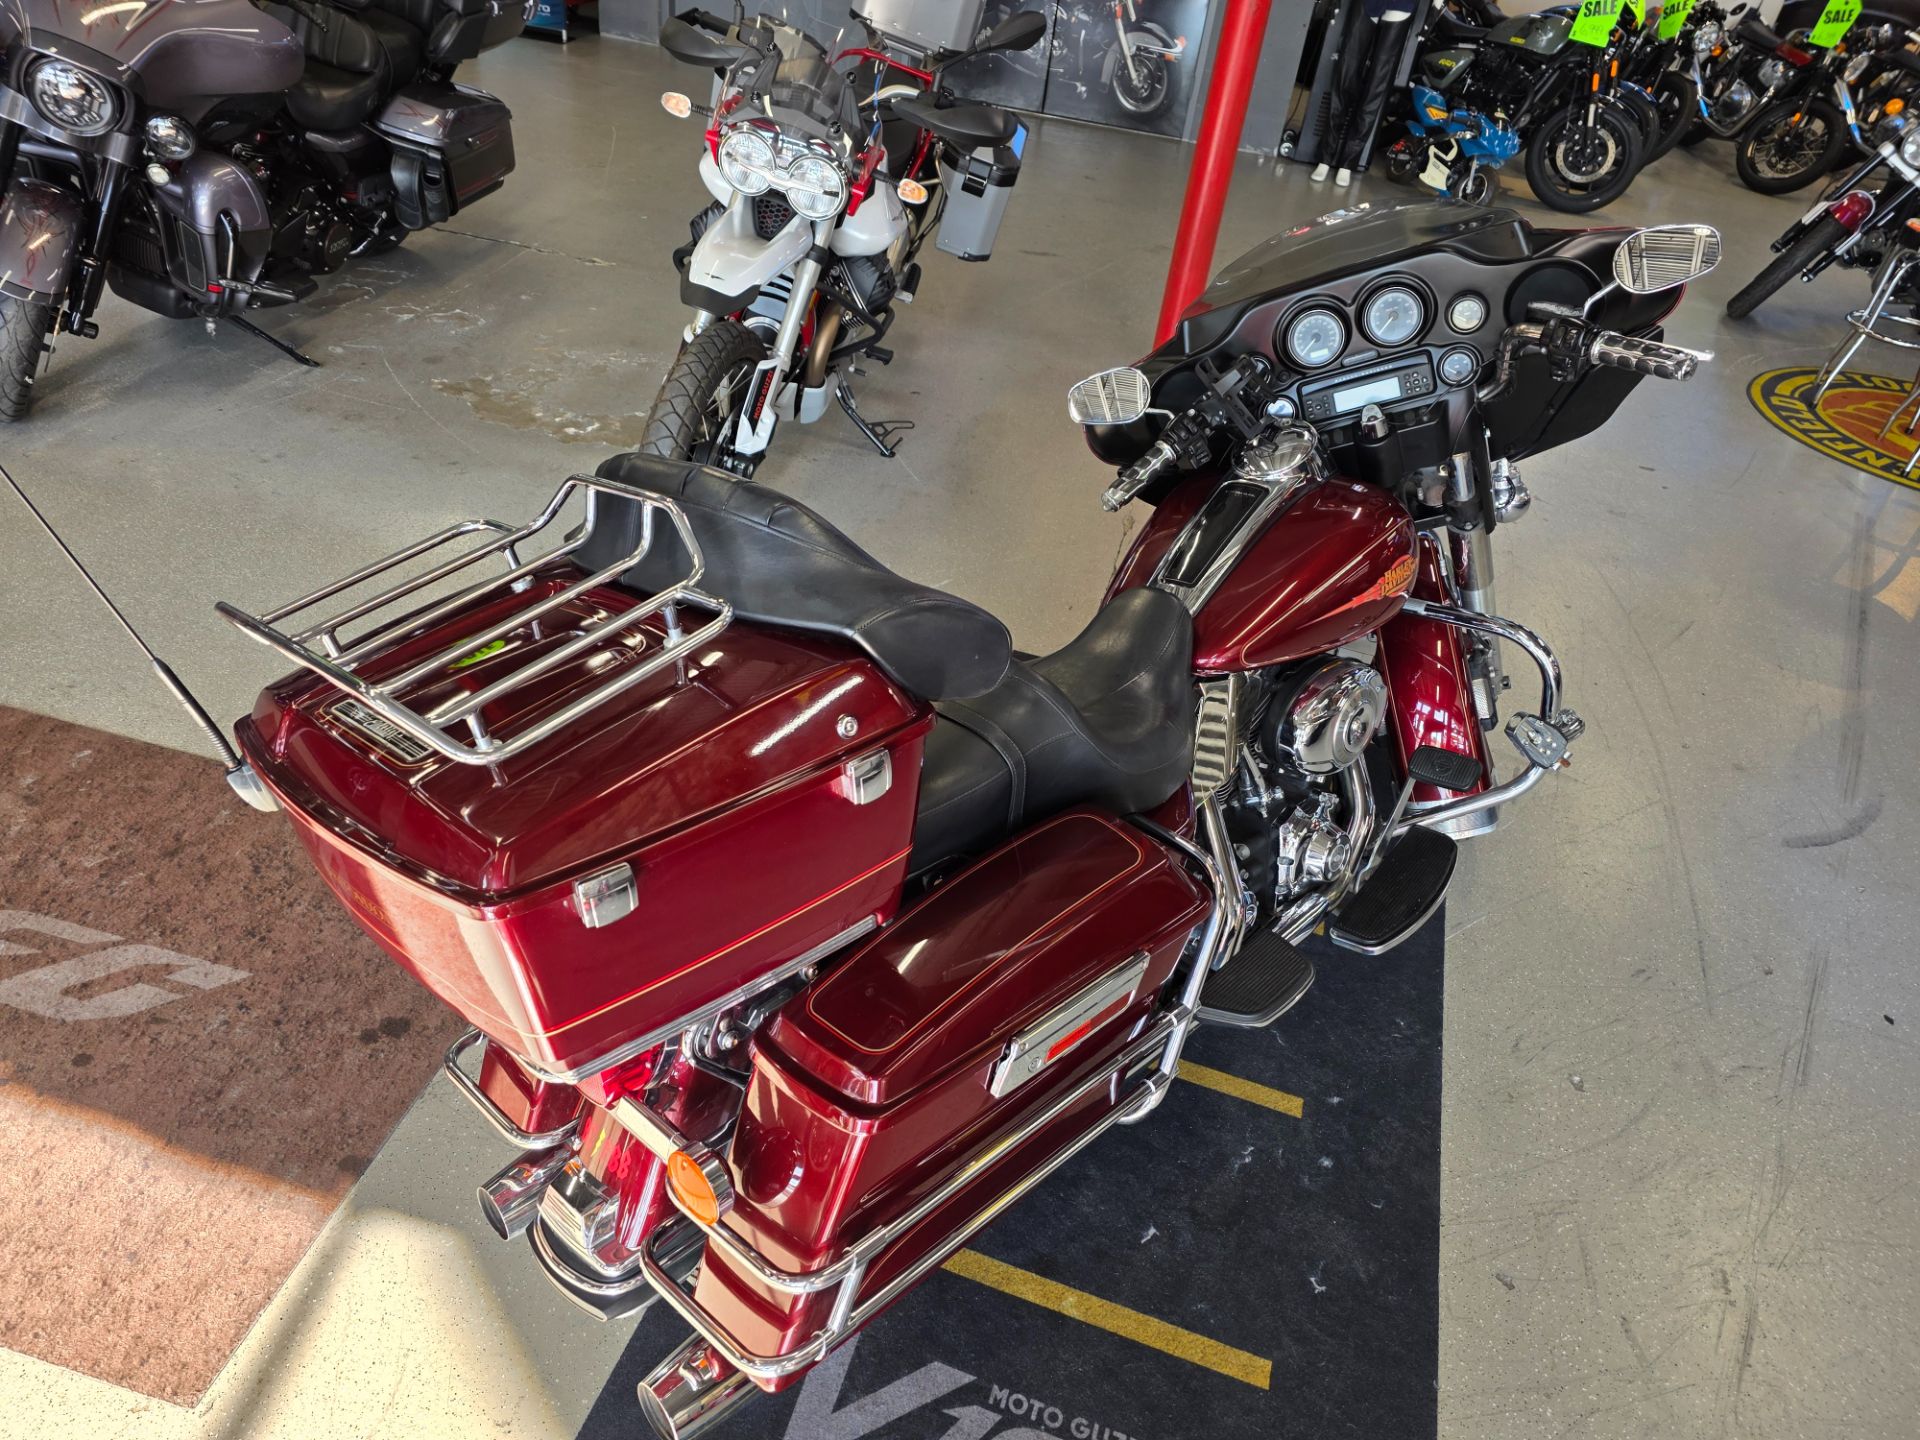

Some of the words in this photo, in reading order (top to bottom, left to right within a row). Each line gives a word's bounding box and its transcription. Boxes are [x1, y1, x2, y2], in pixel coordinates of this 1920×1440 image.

[1583, 0, 1617, 17] SALE
[1663, 0, 1689, 19] SALE
[1823, 8, 1854, 24] SALE
[988, 1383, 1064, 1428] MOTO
